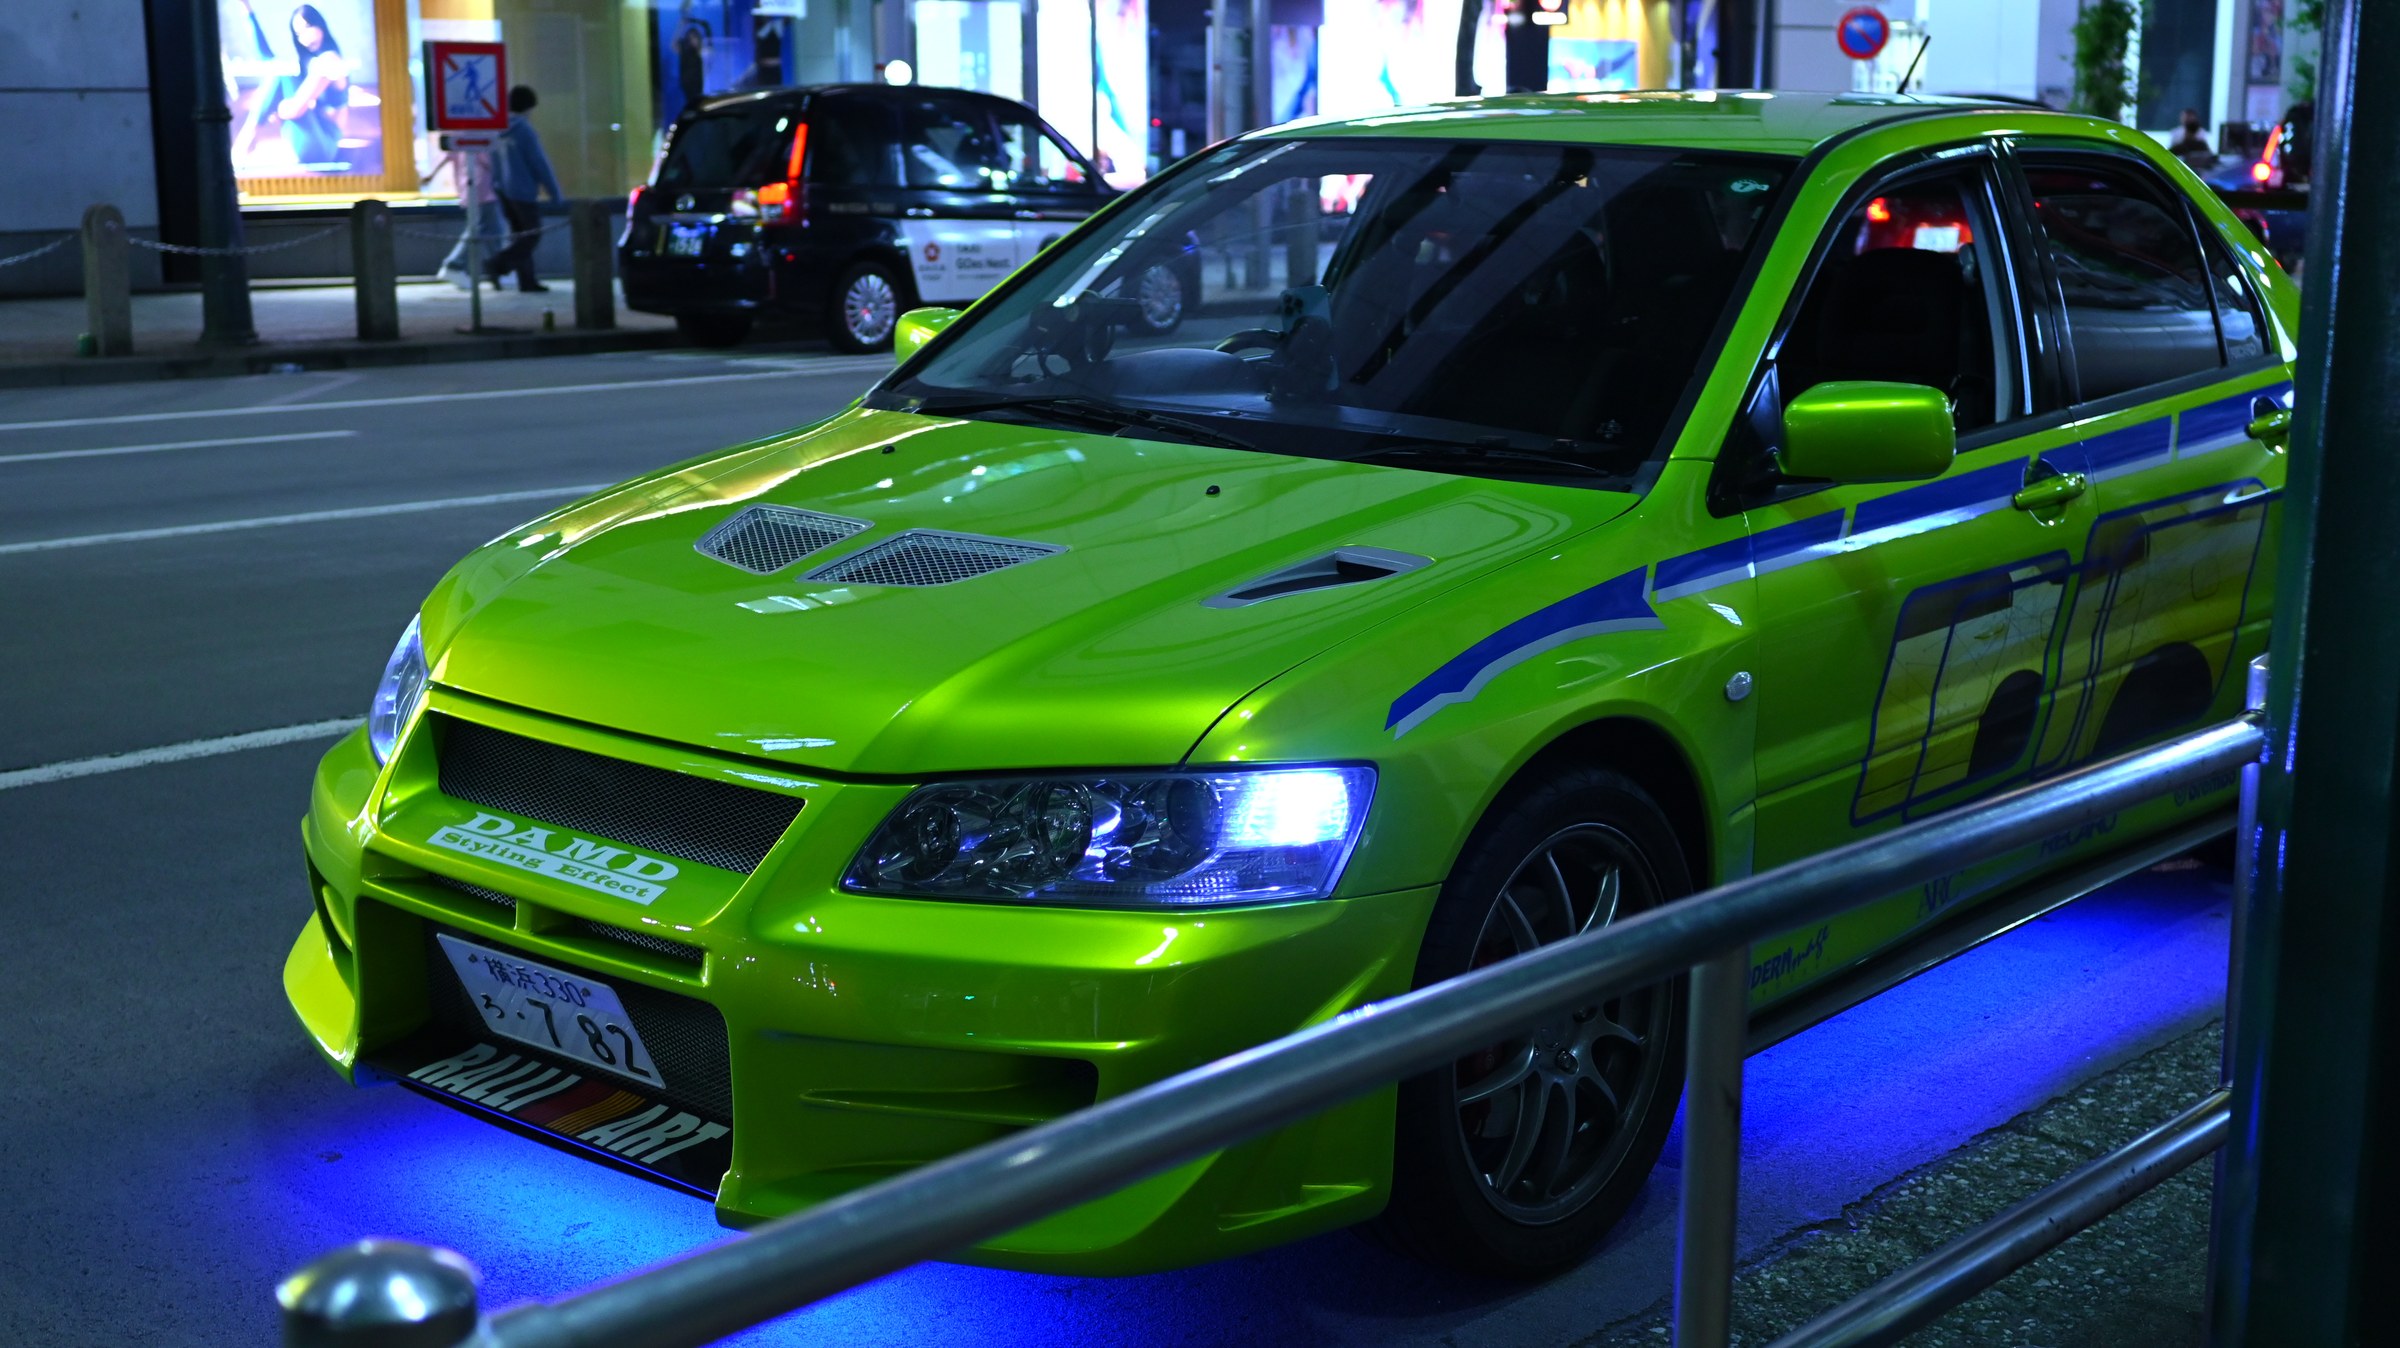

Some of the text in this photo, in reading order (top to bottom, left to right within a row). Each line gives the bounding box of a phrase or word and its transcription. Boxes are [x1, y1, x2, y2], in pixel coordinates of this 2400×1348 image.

[441, 832, 650, 898] Styling Effect
[453, 811, 679, 882] DAMD
[483, 955, 586, 1008] 横浜330
[407, 1042, 731, 1165] RALLI ART
